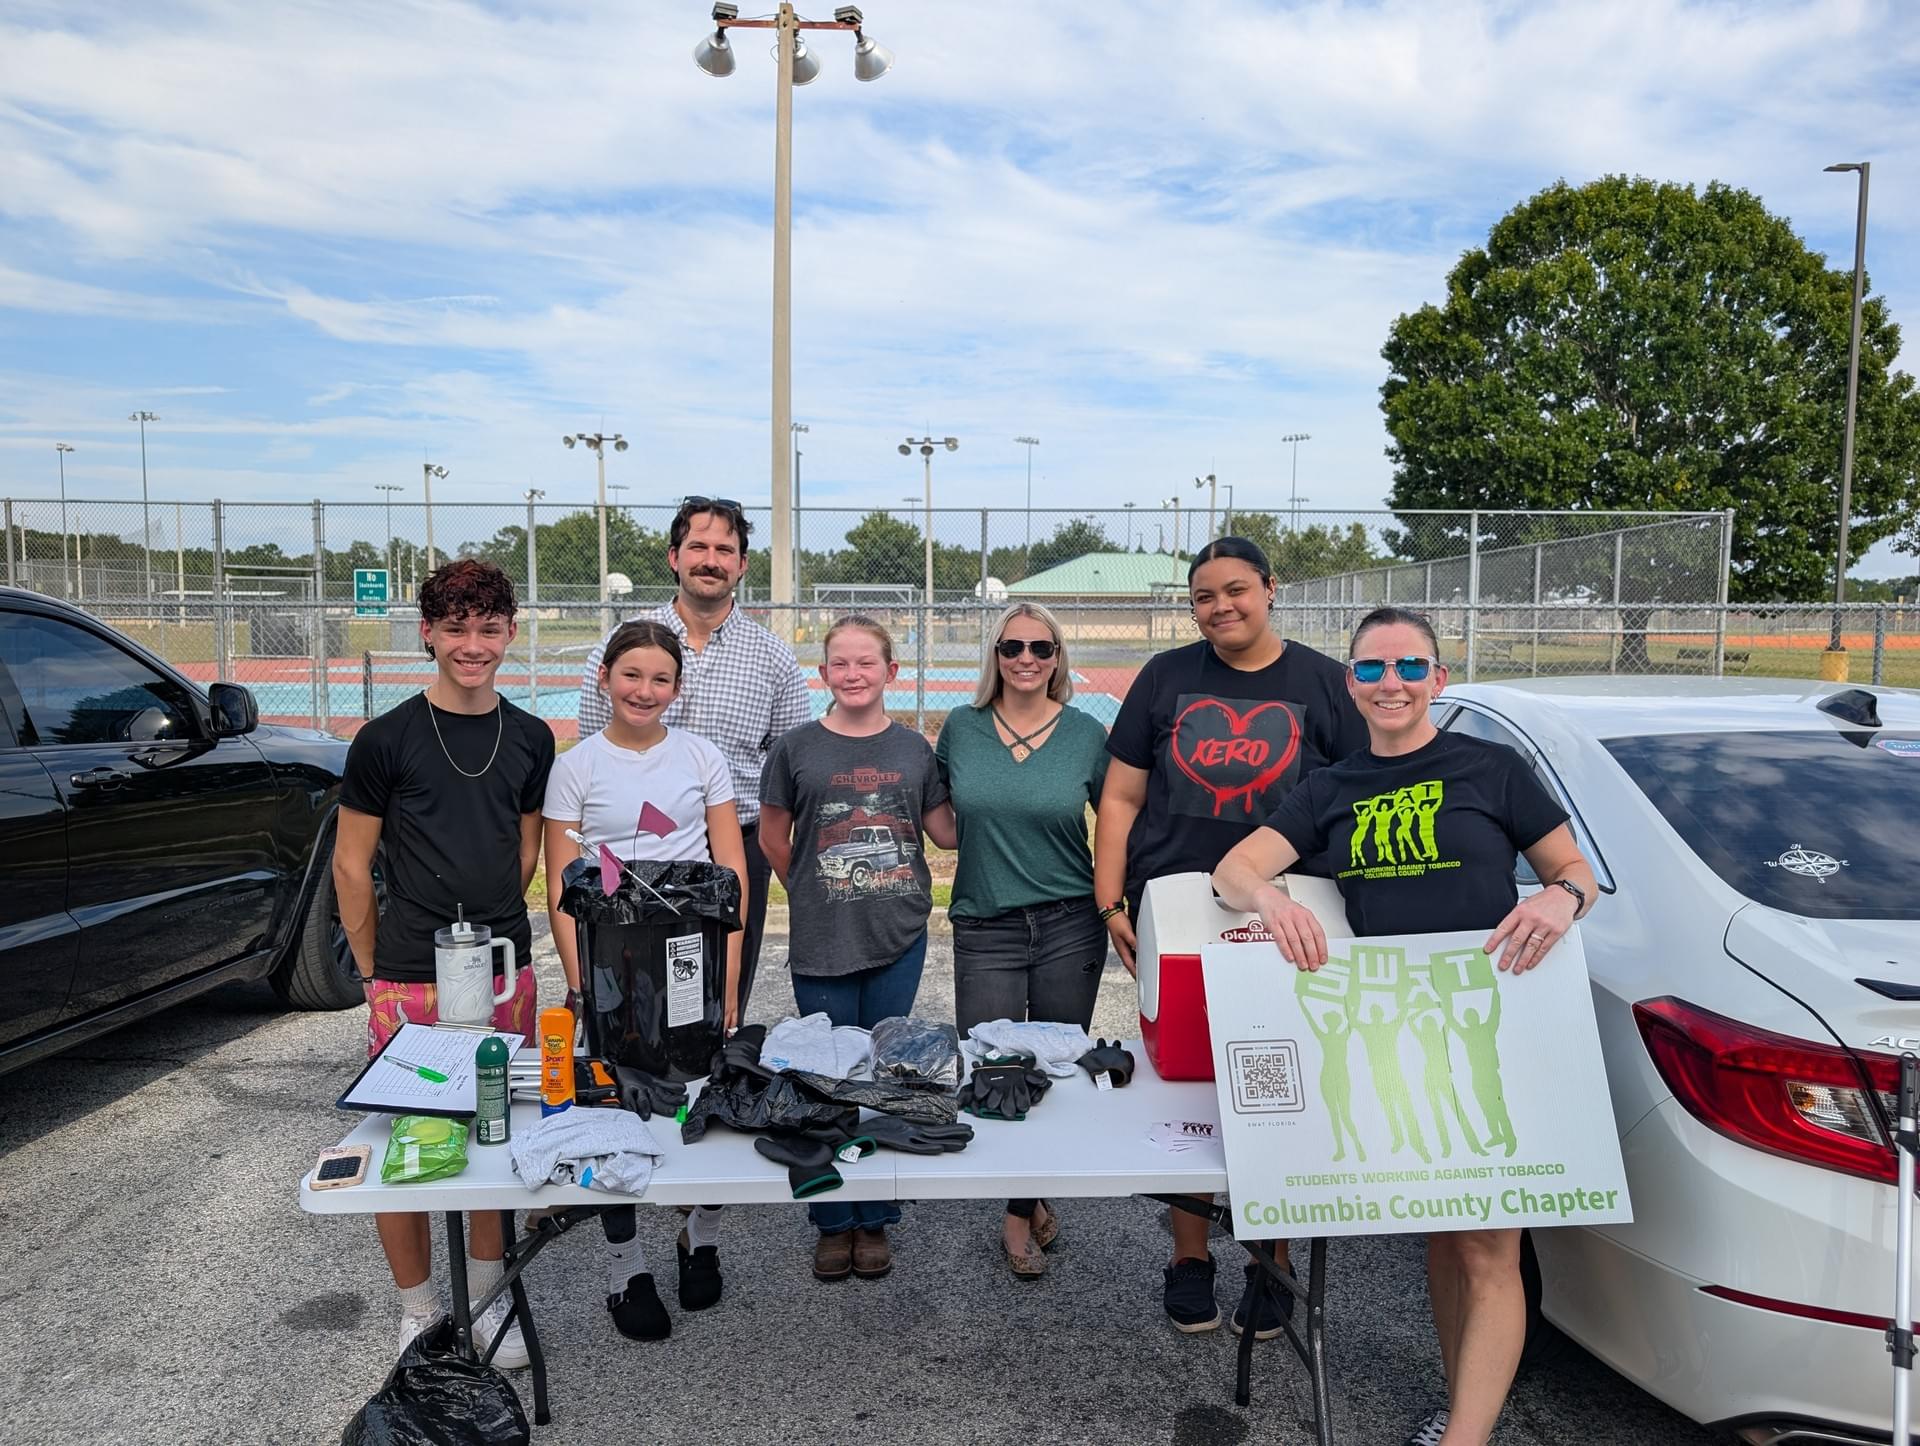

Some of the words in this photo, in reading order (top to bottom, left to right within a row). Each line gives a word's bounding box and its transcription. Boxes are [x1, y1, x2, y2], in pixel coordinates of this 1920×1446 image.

[367, 572, 376, 582] No
[1189, 738, 1269, 766] XERO
[835, 774, 896, 783] CHEVROLET
[1428, 861, 1460, 869] TOBACCO
[1224, 930, 1275, 941] playm
[1285, 1174, 1358, 1187] STUDENTS
[1362, 1170, 1430, 1183] WORKING
[1434, 1166, 1494, 1180] AGAINST
[1498, 1163, 1565, 1177] TOBACCO
[1243, 1195, 1381, 1226] Columbia
[1388, 1192, 1493, 1222] County
[1500, 1187, 1618, 1218] Chapter
